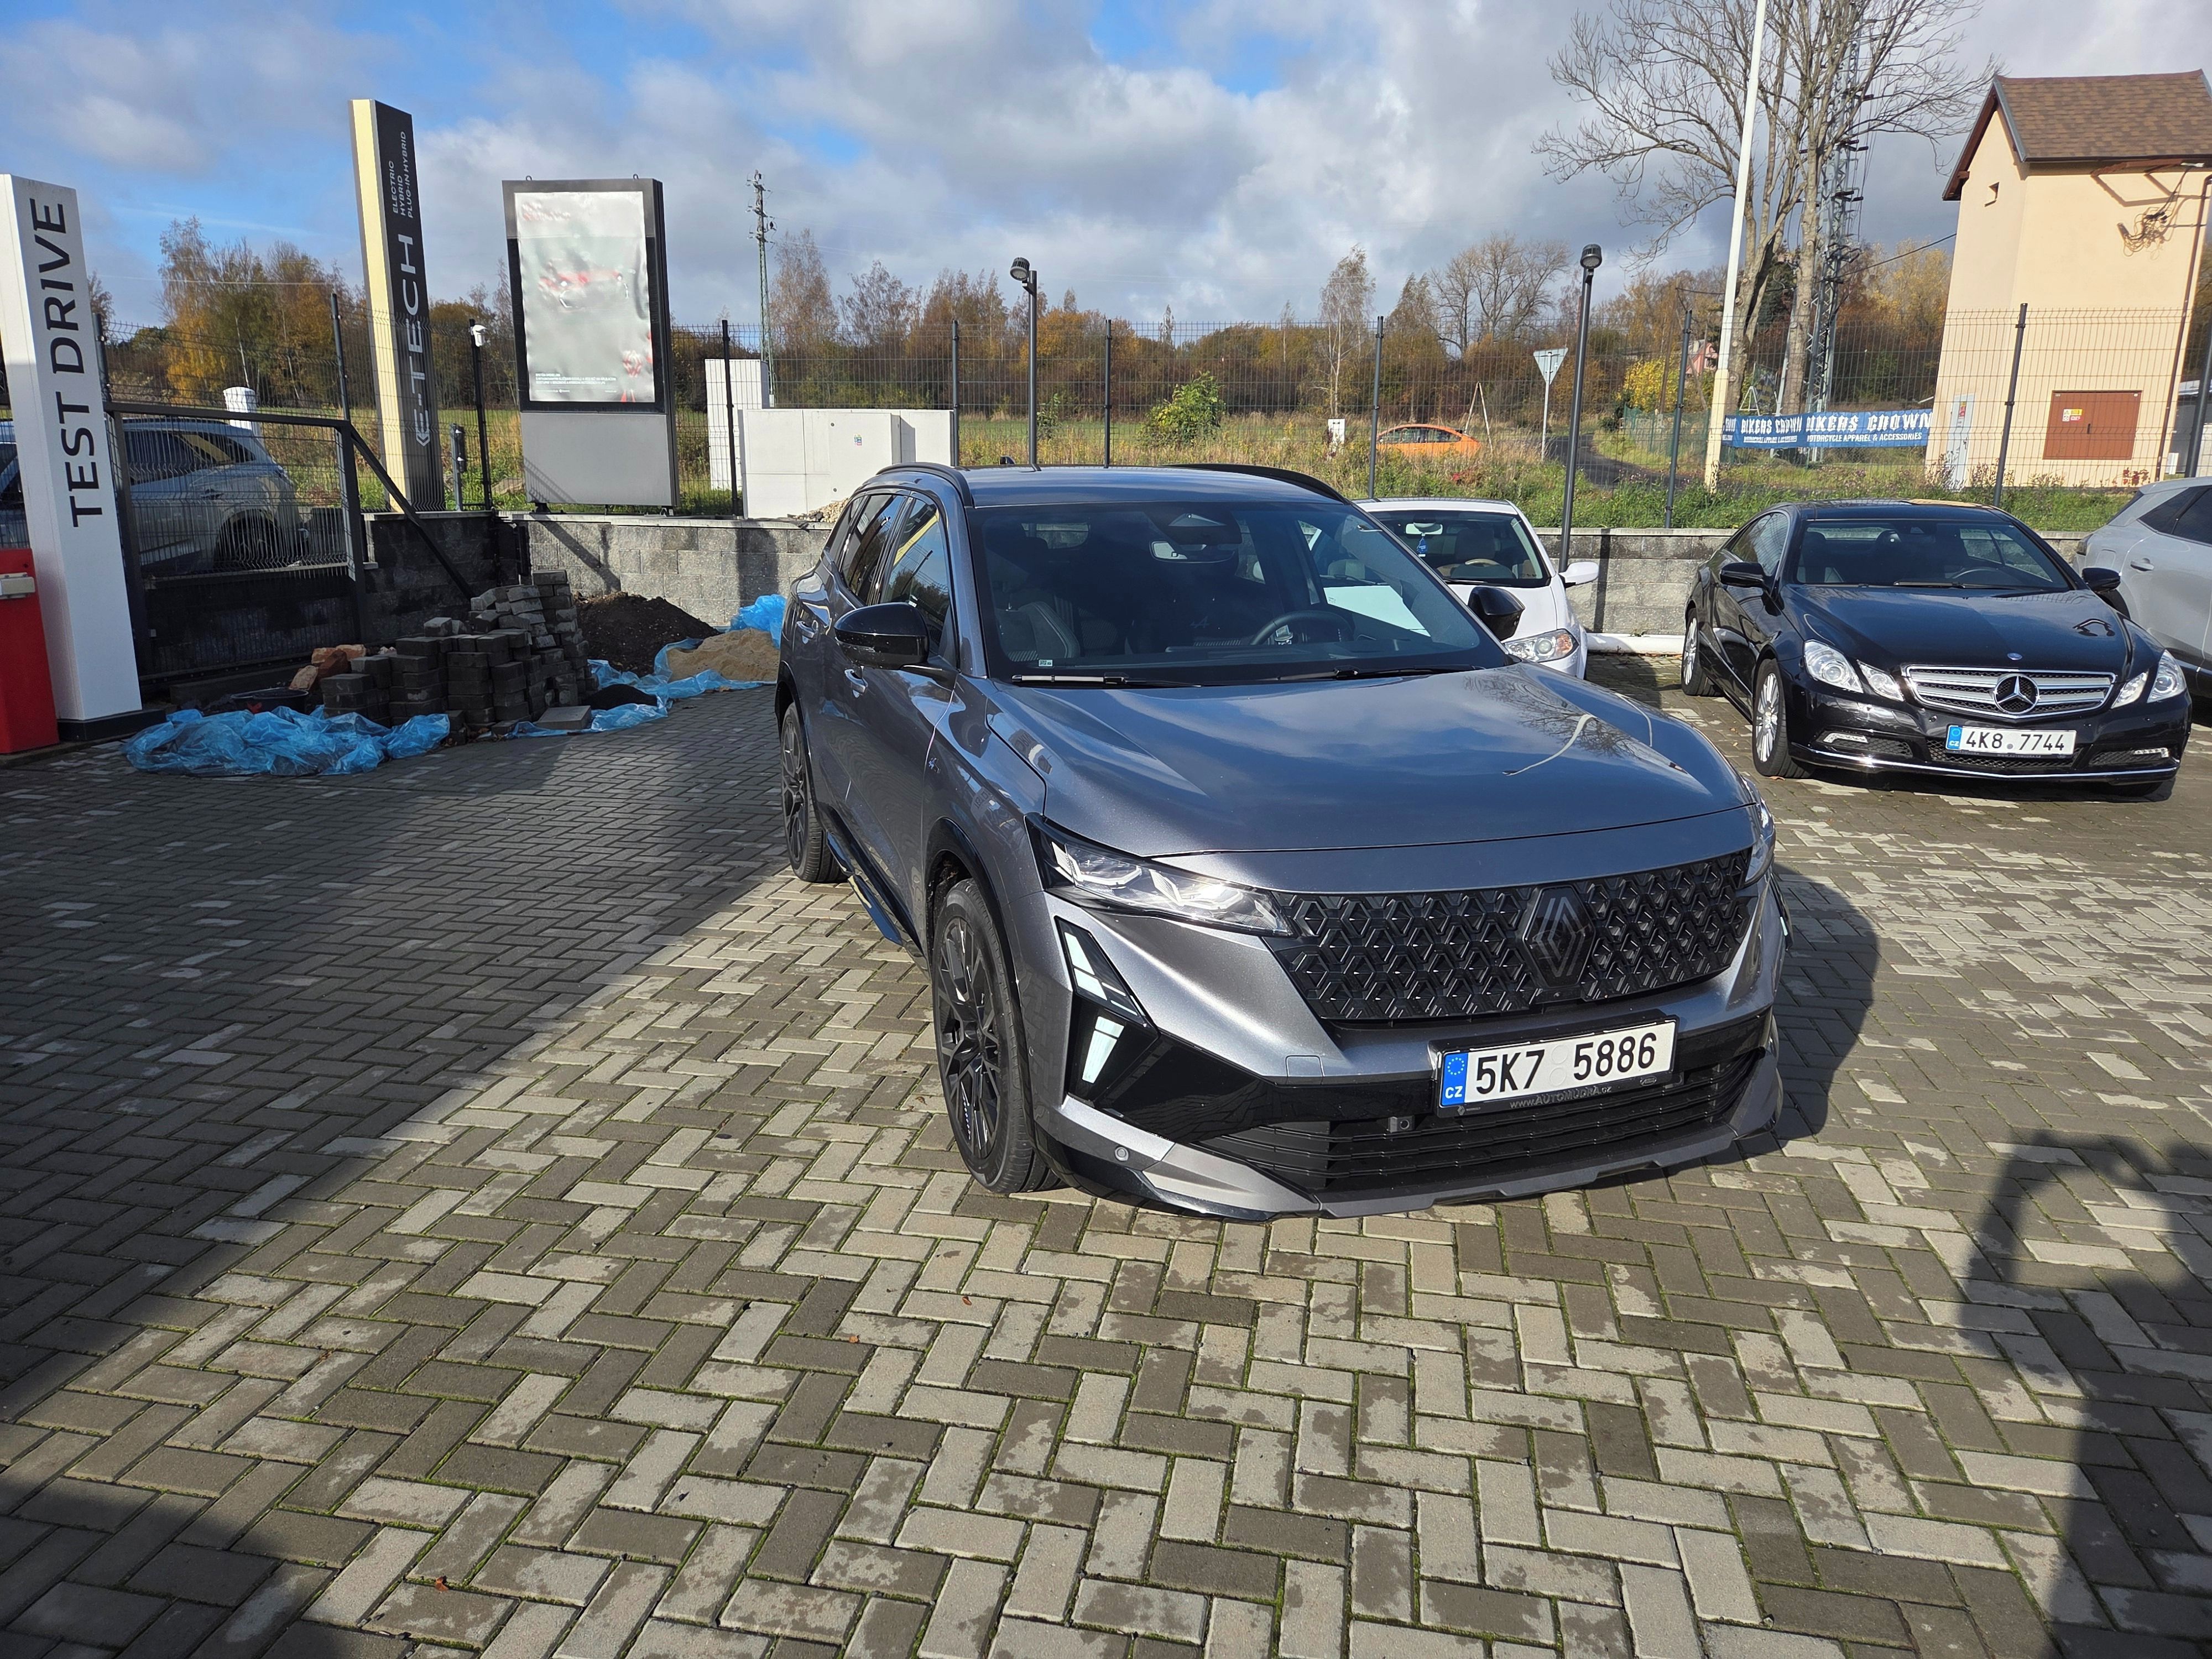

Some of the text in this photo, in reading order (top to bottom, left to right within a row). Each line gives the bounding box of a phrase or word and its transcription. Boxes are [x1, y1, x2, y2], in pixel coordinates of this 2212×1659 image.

[388, 160, 399, 213] ELECTRIC
[397, 175, 406, 216] HYBRID
[400, 131, 414, 218] PLUG-IN HYBRID
[29, 197, 102, 528] TEST DRIVE
[398, 234, 430, 446] E-TECH
[1843, 433, 1871, 442] APPAREL
[1880, 432, 1922, 441] ACCESSORIES
[1867, 411, 1932, 432] CROWN
[1966, 731, 2064, 751] 4K8 7744
[1475, 1032, 1657, 1094] 5K7 5886
[1445, 1086, 1463, 1099] CZ
